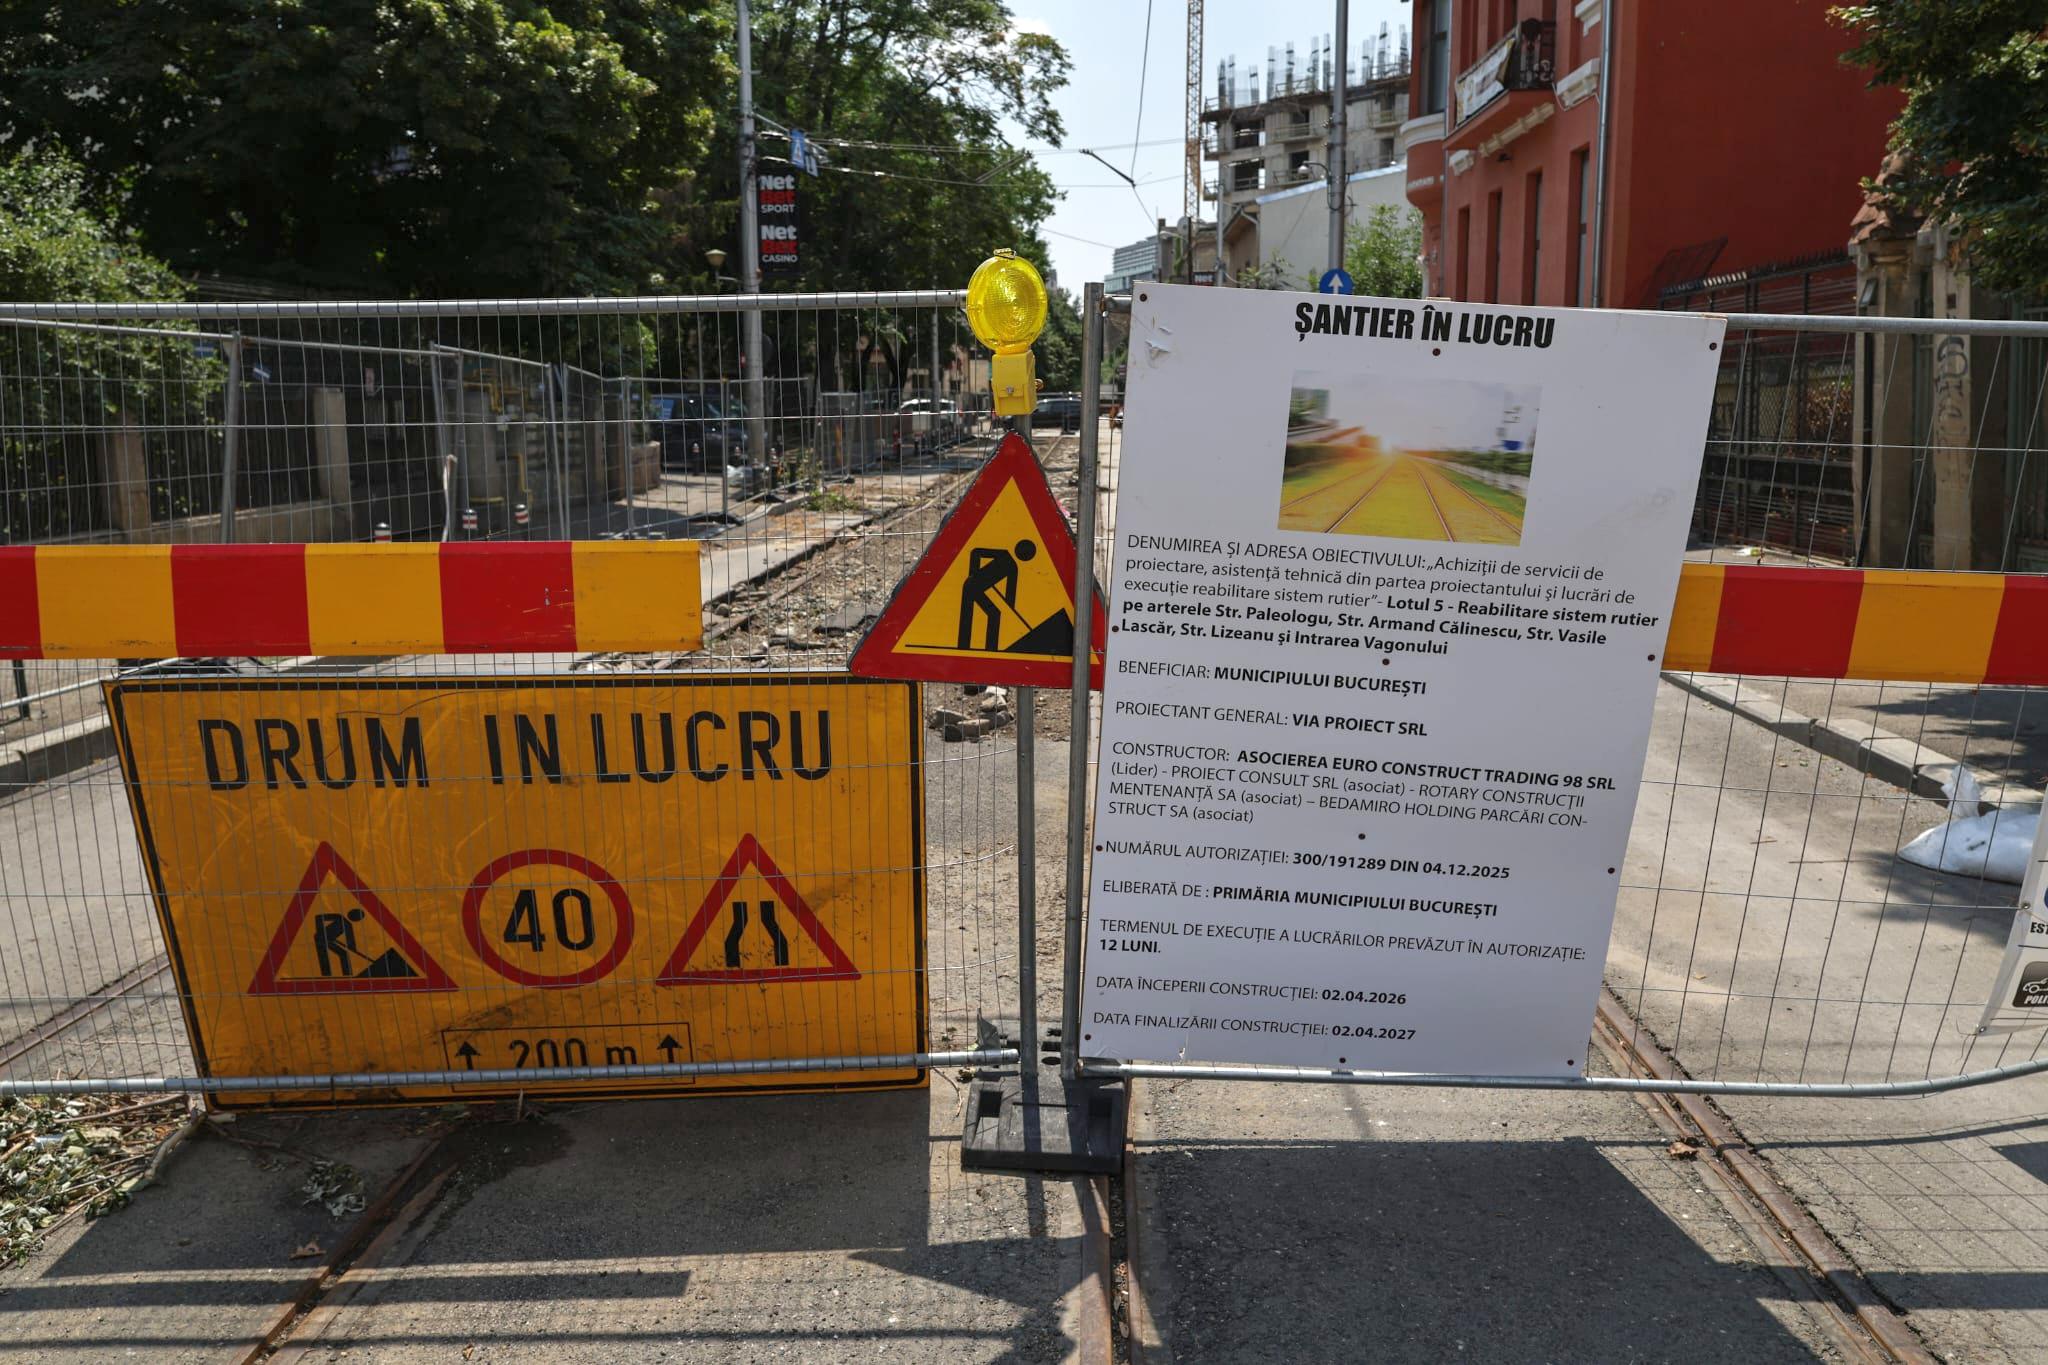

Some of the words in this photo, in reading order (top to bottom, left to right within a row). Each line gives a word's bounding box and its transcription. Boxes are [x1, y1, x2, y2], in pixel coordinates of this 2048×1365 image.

[760, 174, 795, 190] Net
[761, 204, 795, 214] SPORT
[761, 225, 797, 240] Net
[761, 240, 799, 254] Bet
[762, 254, 798, 263] CASINO
[1420, 304, 1453, 343] ÎN
[1457, 312, 1556, 349] LUCRU
[1127, 534, 1223, 554] DENUMIREA
[1243, 543, 1308, 561] ADRESA
[1500, 560, 1521, 575] de
[1524, 564, 1580, 579] servicii
[1583, 566, 1604, 581] de
[1125, 557, 1208, 576] proiectare,
[1284, 567, 1342, 584] tehnică
[1346, 571, 1371, 586] din
[1375, 576, 1426, 590] partea
[1429, 579, 1542, 598] proiectantului
[1561, 585, 1611, 603] lucrări
[1614, 589, 1635, 605] de
[1122, 600, 1144, 615] pe
[1146, 601, 1212, 617] arterele
[1215, 604, 1242, 619] Str.
[1246, 606, 1333, 628] Paleologu,
[1336, 612, 1364, 628] Str.
[1367, 615, 1436, 633] Armand
[1438, 620, 1522, 641] Călinescu,
[1526, 626, 1554, 641] Str.
[1558, 628, 1607, 645] Vasile
[1192, 582, 1270, 600] reabilitare
[1273, 587, 1324, 604] sistem
[1386, 595, 1431, 612] Lotul
[1433, 599, 1444, 613] 5
[1457, 600, 1549, 620] Reabilitare
[1552, 607, 1607, 624] sistem
[1610, 612, 1660, 627] rutier
[1121, 617, 1177, 637] Lascăr,
[1179, 622, 1207, 637] Str.
[1210, 624, 1274, 642] Lizeanu
[1294, 630, 1360, 648] Intrarea
[1363, 635, 1448, 655] Vagonului
[1118, 659, 1210, 679] BENEFICIAR:
[1213, 666, 1330, 688] MUNICIPIULUI
[1115, 700, 1212, 720] PROIECTANT
[1213, 707, 1289, 726] GENERAL:
[1292, 713, 1320, 728] VIA
[1324, 715, 1396, 734] PROIECT
[1397, 721, 1428, 737] SRL
[198, 717, 430, 791] DRUM
[484, 714, 562, 785] IN
[591, 710, 832, 784] LUCRU
[1112, 741, 1230, 762] CONSTRUCTOR:
[1236, 749, 1329, 769] ASOCIEREA
[1332, 757, 1378, 773] EURO
[1381, 761, 1482, 781] CONSTRUCT
[1483, 768, 1560, 787] TRADING
[1562, 775, 1583, 788] 98
[1586, 776, 1616, 791] SRL
[1111, 761, 1158, 779] (Lider)
[1171, 765, 1236, 782] PROIECT
[1238, 770, 1310, 787] CONSULT
[1312, 775, 1340, 790] SRL
[1343, 777, 1405, 797] (asociat)
[1418, 784, 1480, 800] ROTARY
[1108, 801, 1167, 817] STRUCT
[1169, 804, 1189, 818] SA
[1192, 806, 1254, 824] (asociat)
[1217, 788, 1237, 802] SA
[1241, 789, 1302, 808] (asociat)
[1319, 795, 1401, 814] BEDAMIRO
[1404, 802, 1476, 820] HOLDING
[1480, 808, 1545, 825] PARCĂRI
[1547, 813, 1587, 827] CON-
[1105, 840, 1182, 857] NUMĂRUL
[1292, 852, 1387, 871] 300/191289
[1389, 859, 1420, 873] DIN
[1422, 861, 1511, 879] 04.12.2025
[1103, 879, 1178, 897] ELIBERATĂ
[1182, 884, 1202, 898] DE
[1212, 885, 1291, 903] PRIMĂRIA
[1294, 891, 1406, 911] MUNICIPIULUI
[503, 889, 596, 953] 40
[1099, 918, 1180, 935] TERMENUL
[1183, 923, 1203, 937] DE
[1279, 929, 1290, 942] A
[1293, 929, 1385, 948] LUCRĂRILOR
[1388, 936, 1466, 953] PREVĂZUT
[1467, 939, 1484, 954] ÎN
[1099, 938, 1118, 951] 12
[1121, 939, 1161, 954] LUNI.
[1096, 976, 1134, 990] DATA
[1137, 976, 1206, 993] ÎNCEPERII
[1321, 989, 1407, 1005] 02.04.2026
[2024, 995, 2048, 1005] POLI
[1093, 1012, 1131, 1026] DATA
[1134, 1014, 1217, 1030] FINALIZĂRII
[1331, 1025, 1417, 1040] 02.04.2027
[509, 1037, 588, 1069] 200
[605, 1045, 637, 1066] m
